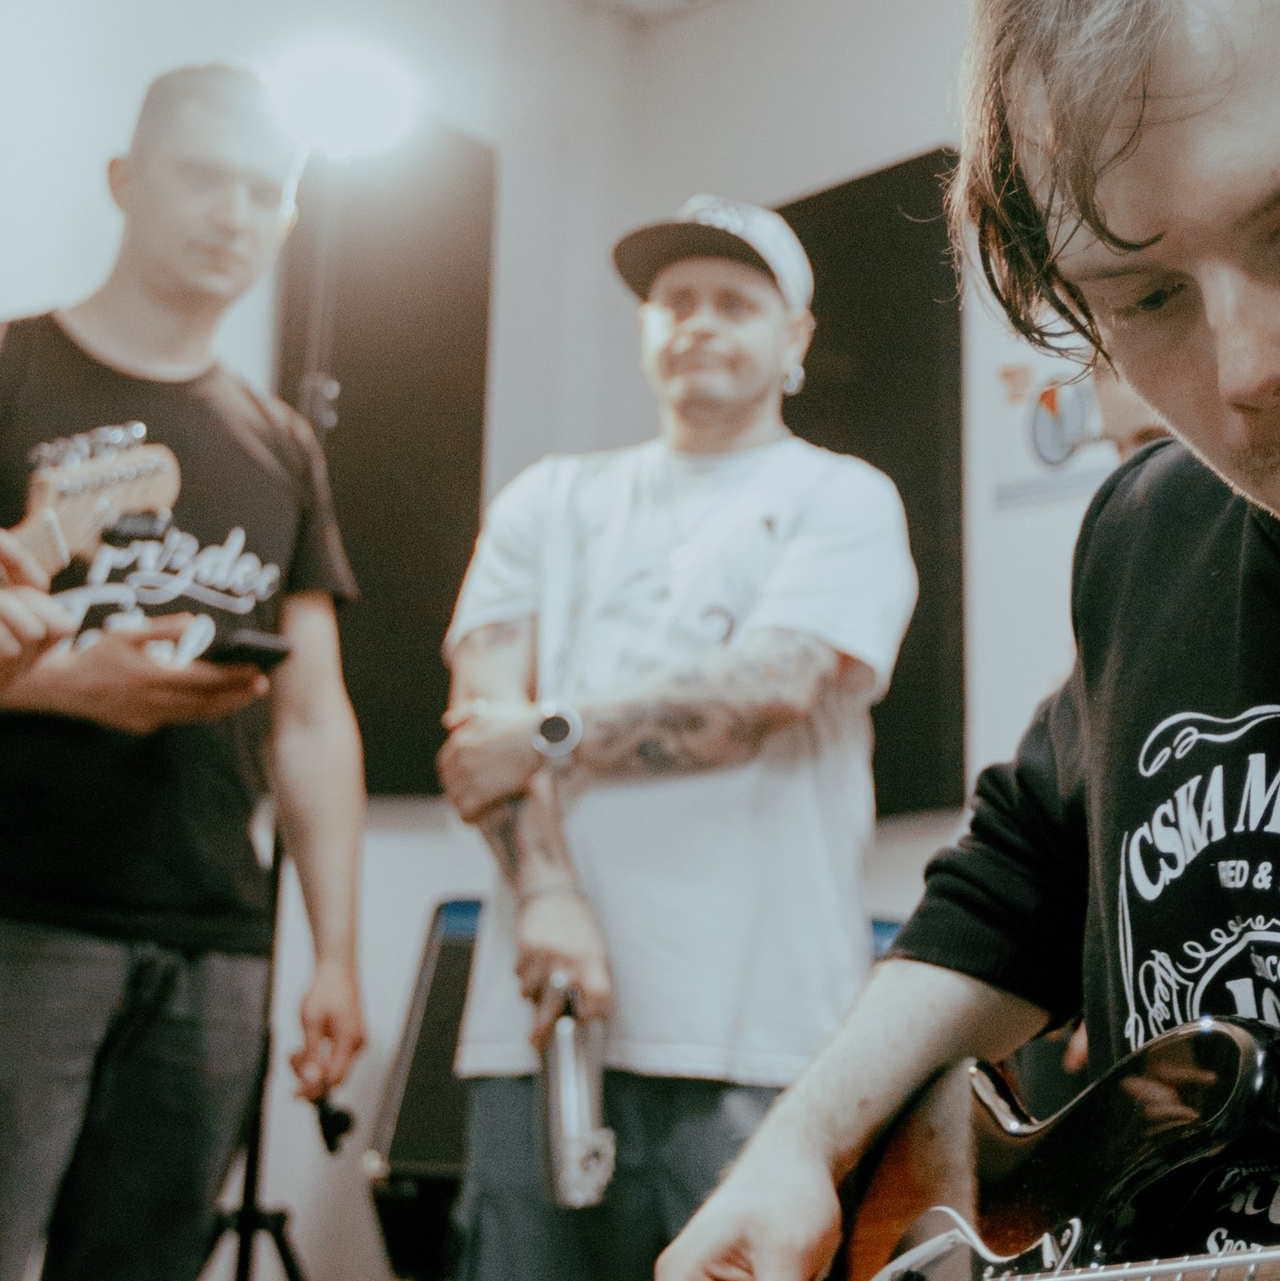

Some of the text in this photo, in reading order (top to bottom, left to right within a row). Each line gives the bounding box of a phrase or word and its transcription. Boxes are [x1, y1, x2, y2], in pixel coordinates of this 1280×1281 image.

[1130, 765, 1226, 901] CSKA
[1217, 859, 1250, 889] ED
[1252, 861, 1273, 890] &
